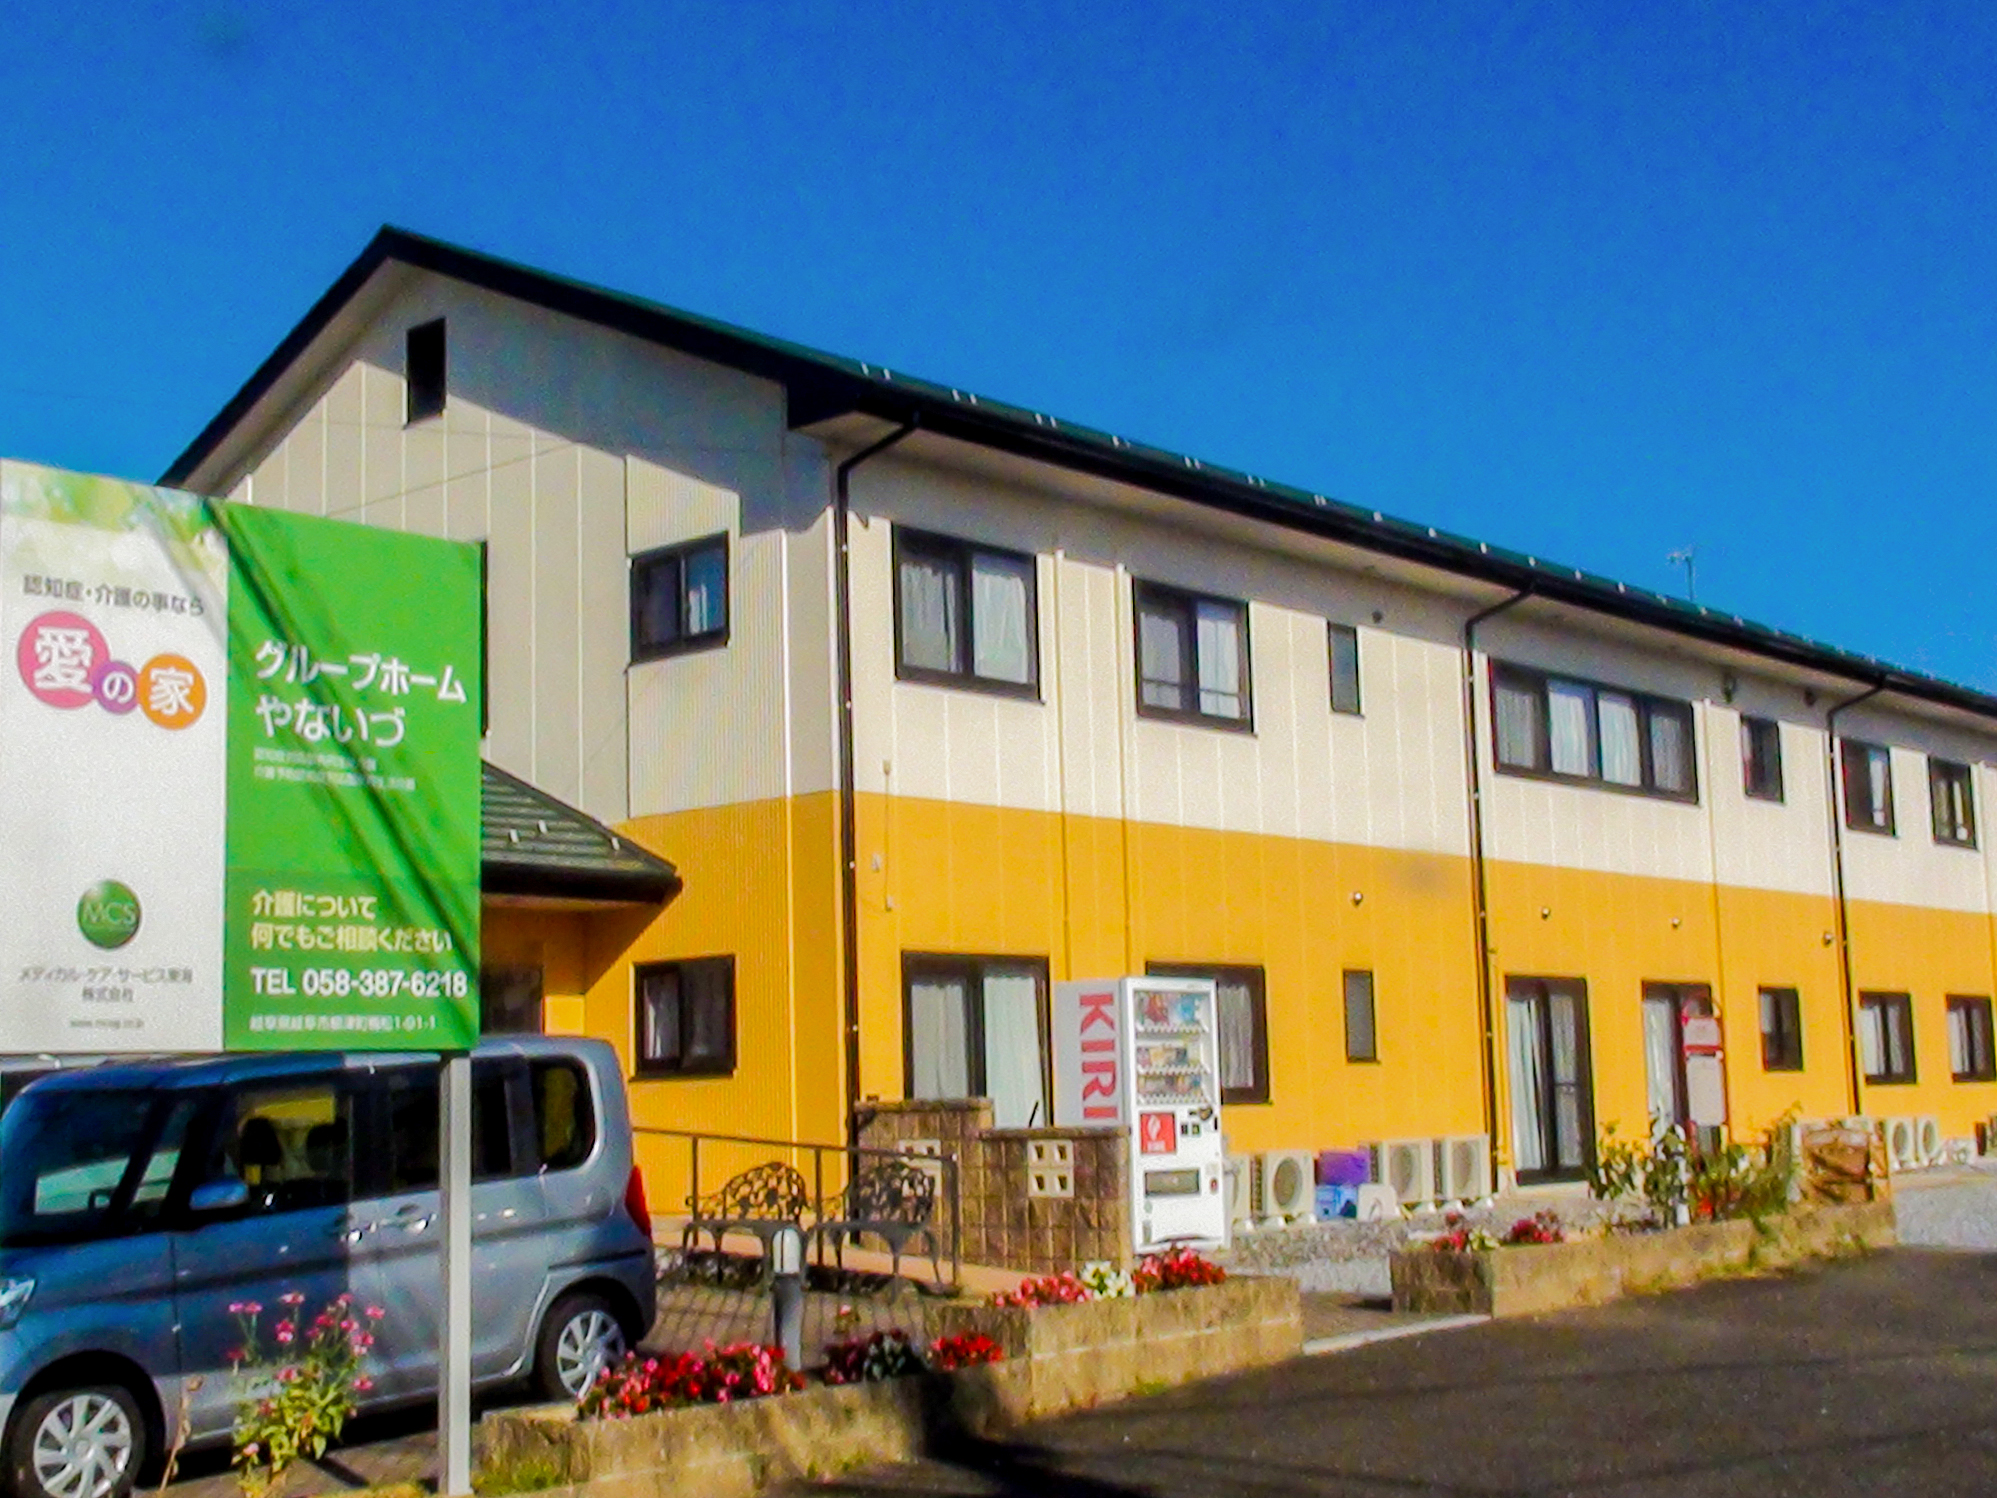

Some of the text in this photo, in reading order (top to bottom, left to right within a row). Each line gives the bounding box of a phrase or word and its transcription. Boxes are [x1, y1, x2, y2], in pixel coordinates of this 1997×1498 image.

[33, 625, 194, 716] 愛の家
[255, 640, 467, 704] グループホーム
[255, 694, 406, 747] やないづ
[83, 901, 136, 924] MCS
[252, 889, 377, 920] 介護について
[251, 922, 453, 953] 何でもご相談ください
[251, 967, 468, 998] TEL 058-387-6218
